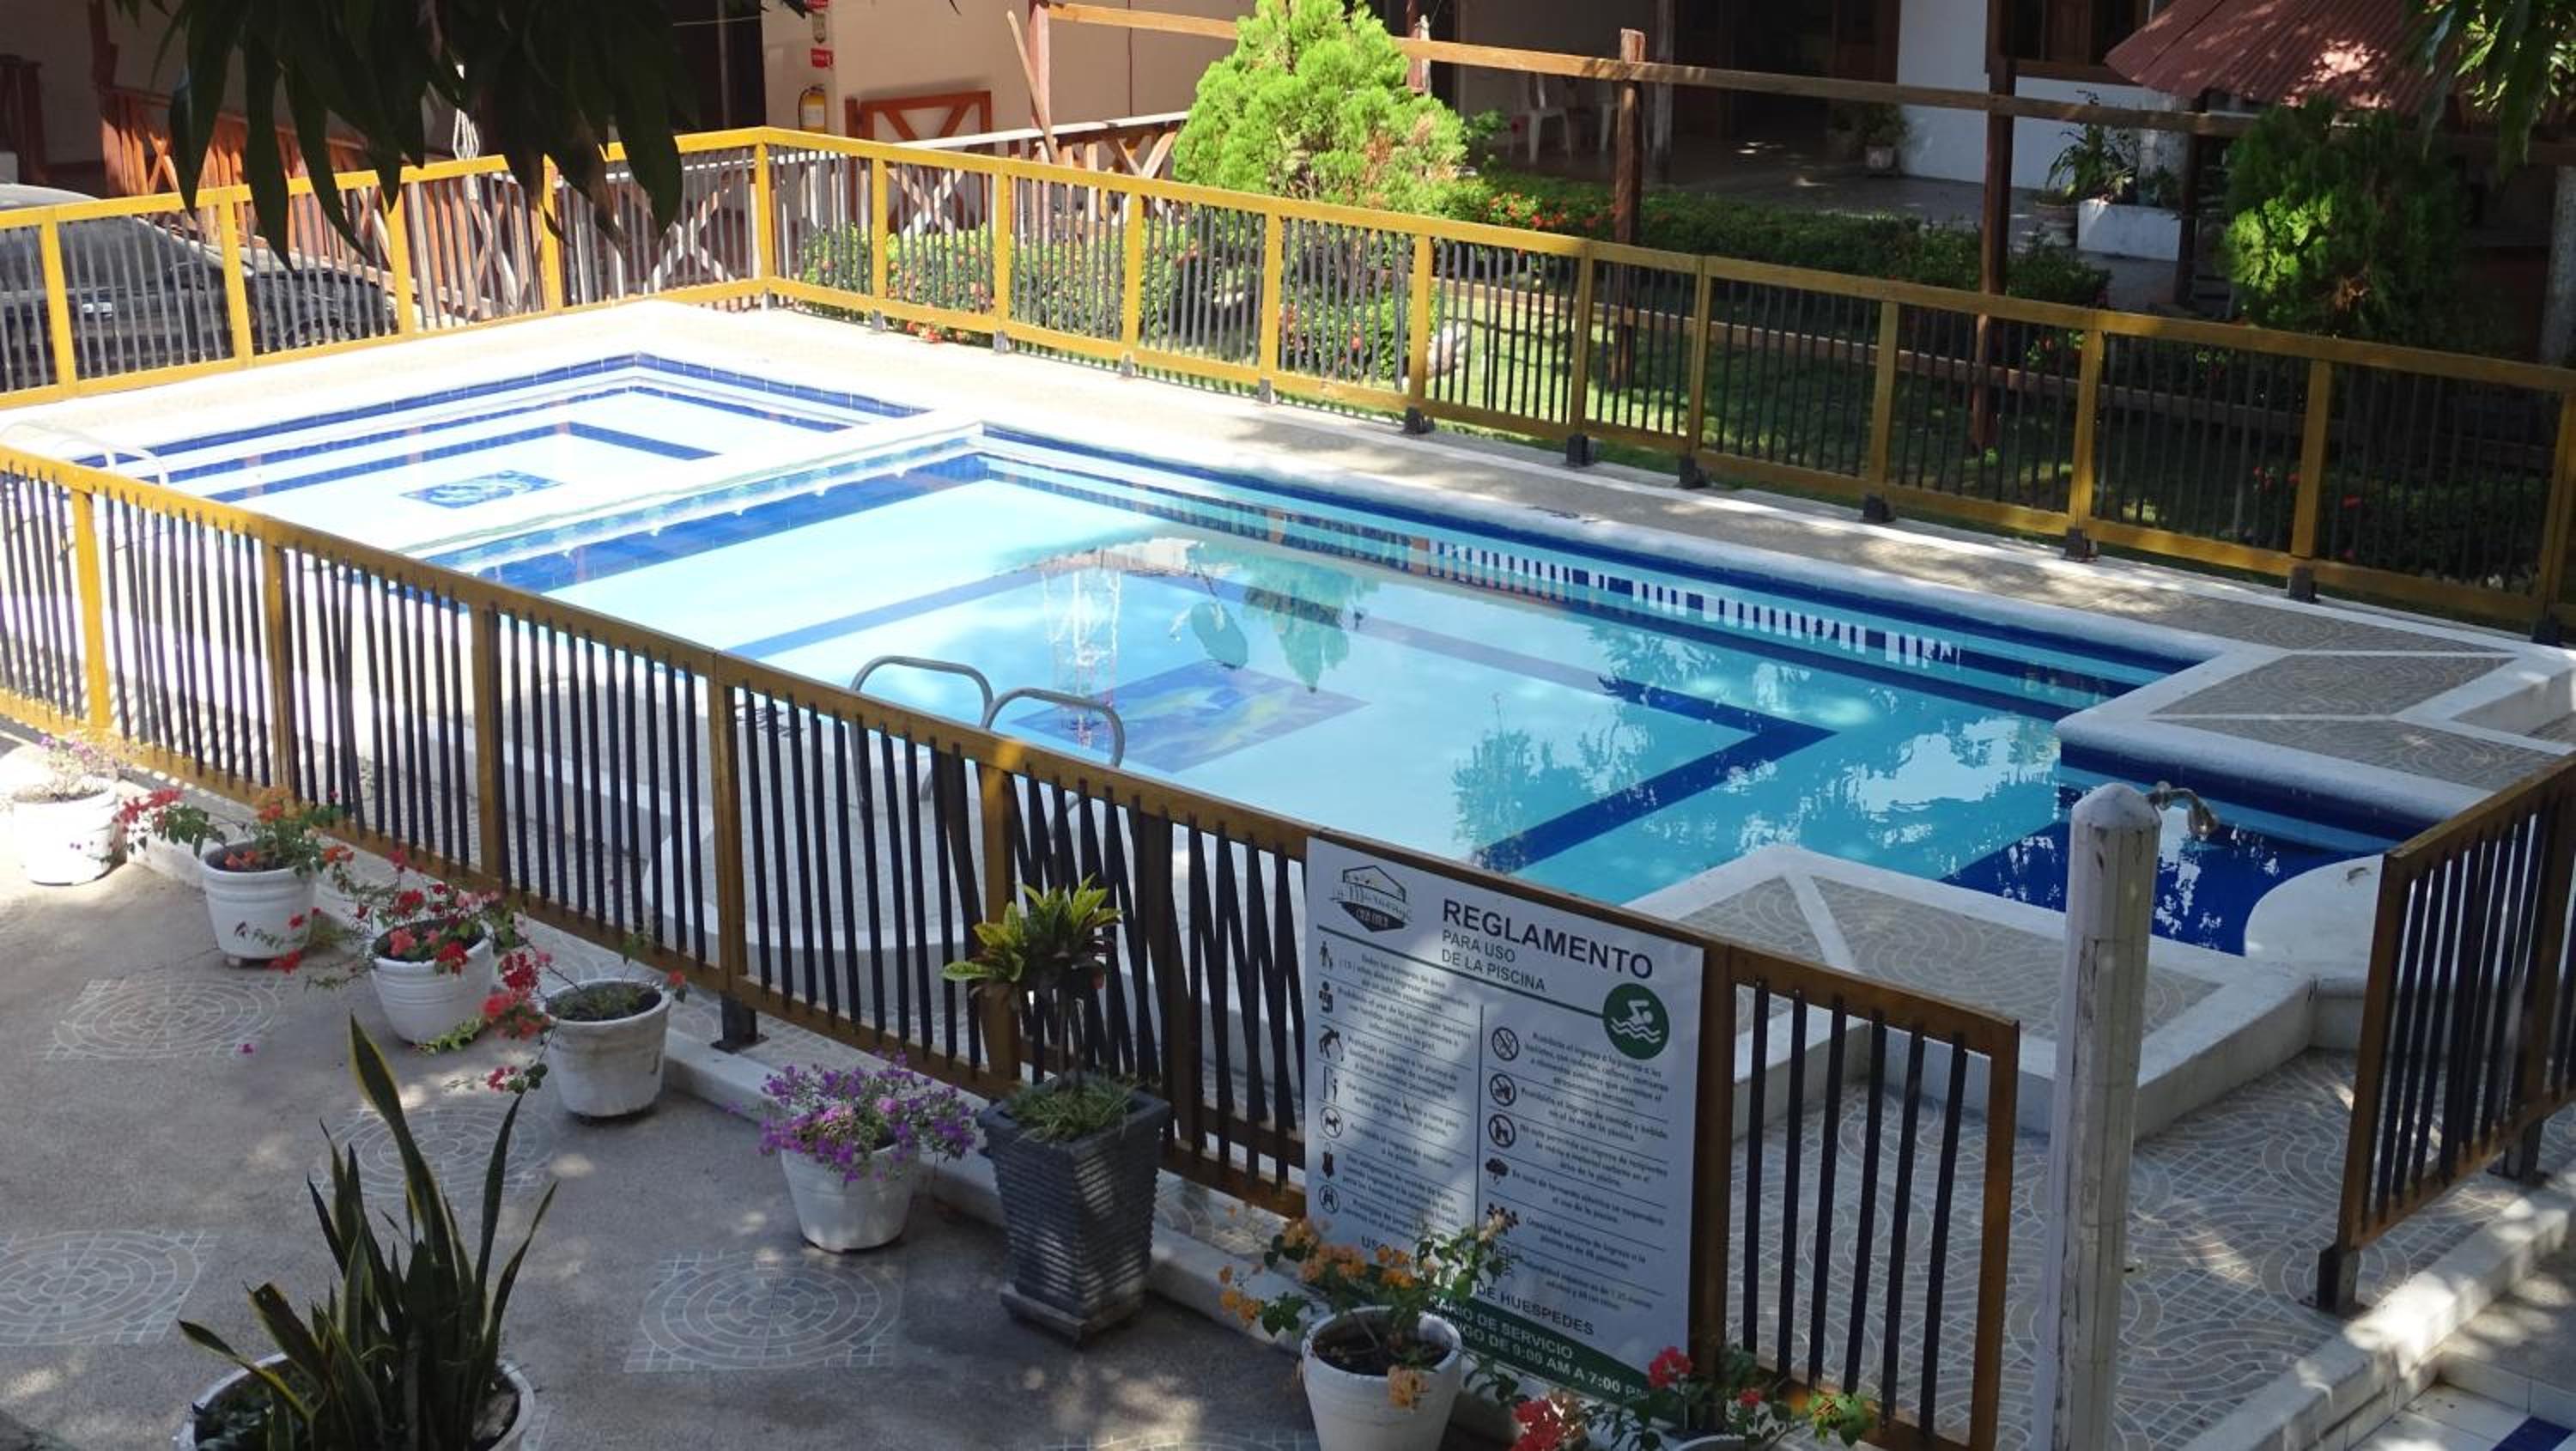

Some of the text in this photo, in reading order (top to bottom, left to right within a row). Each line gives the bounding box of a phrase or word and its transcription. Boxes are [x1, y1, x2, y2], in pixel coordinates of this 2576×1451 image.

[1443, 899, 1653, 980] REGLAMENTO
[1443, 929, 1516, 963] PARA USO
[1442, 949, 1545, 990] DE LA PISCINA
[1477, 1283, 1497, 1301] DE
[1500, 1290, 1595, 1336] HUESPEDES
[1477, 1314, 1498, 1333] DE
[1501, 1322, 1573, 1359] SERVICIO
[1546, 1357, 1571, 1375] AM
[1573, 1367, 1585, 1381] A
[1588, 1371, 1621, 1393] 7:00
